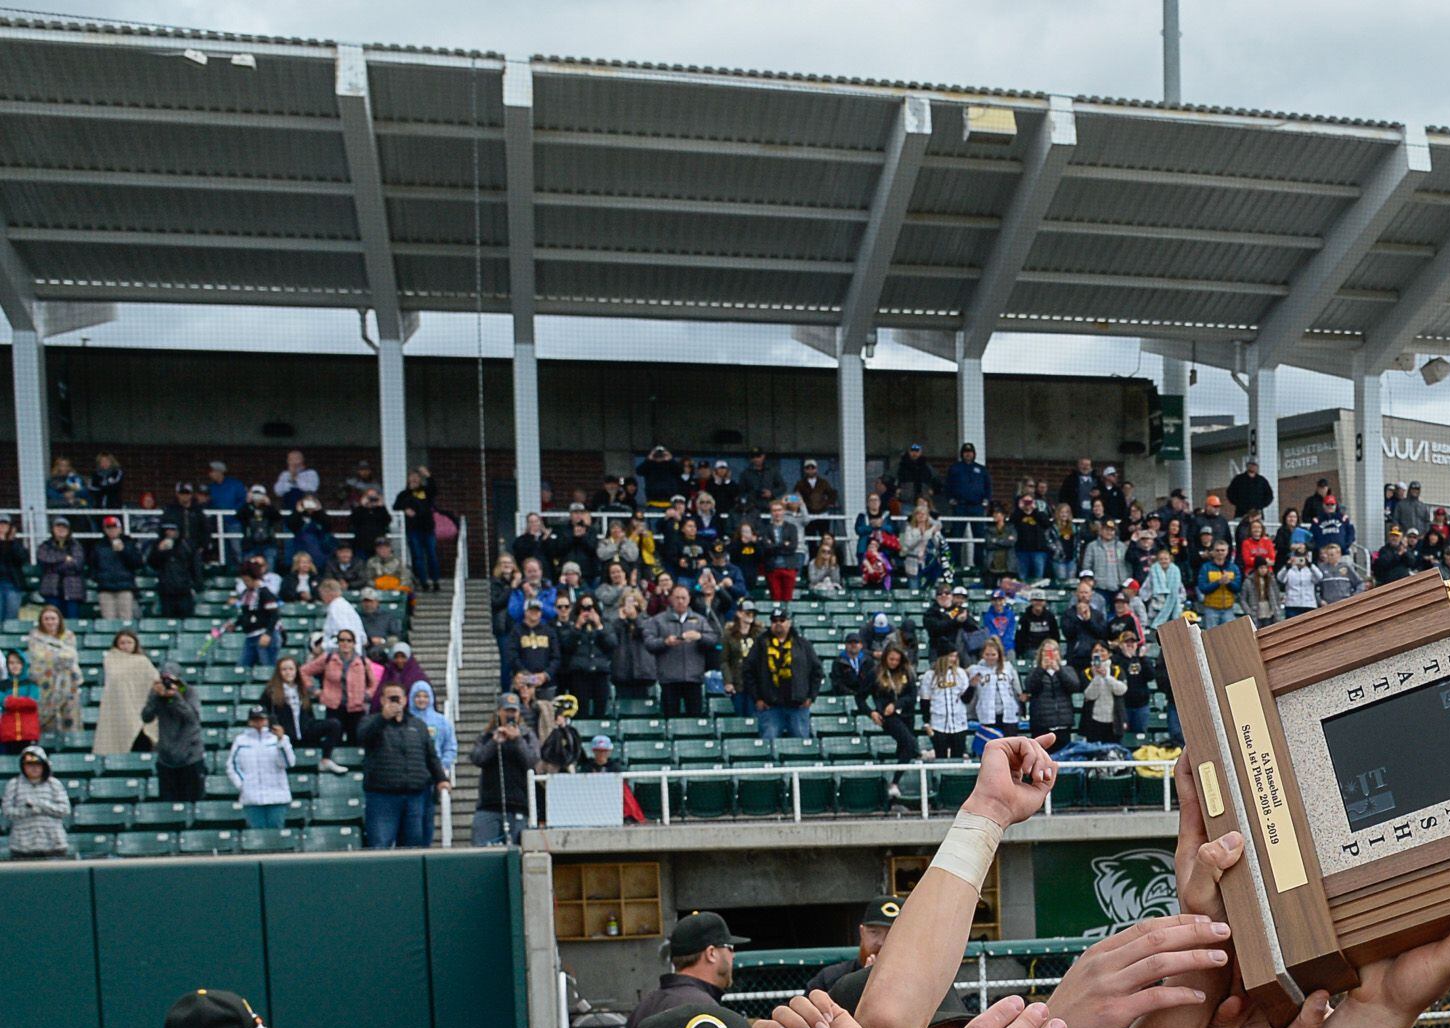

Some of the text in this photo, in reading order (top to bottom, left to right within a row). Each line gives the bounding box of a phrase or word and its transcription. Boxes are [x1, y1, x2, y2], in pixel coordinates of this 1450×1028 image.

[1284, 455, 1319, 469] CENTER
[1241, 724, 1253, 749] State
[1248, 750, 1258, 765] 1st
[1252, 765, 1264, 793] Place
[1260, 752, 1283, 808] 5A Baseball
[1259, 793, 1272, 816] 2018
[1266, 822, 1280, 845] 2019
